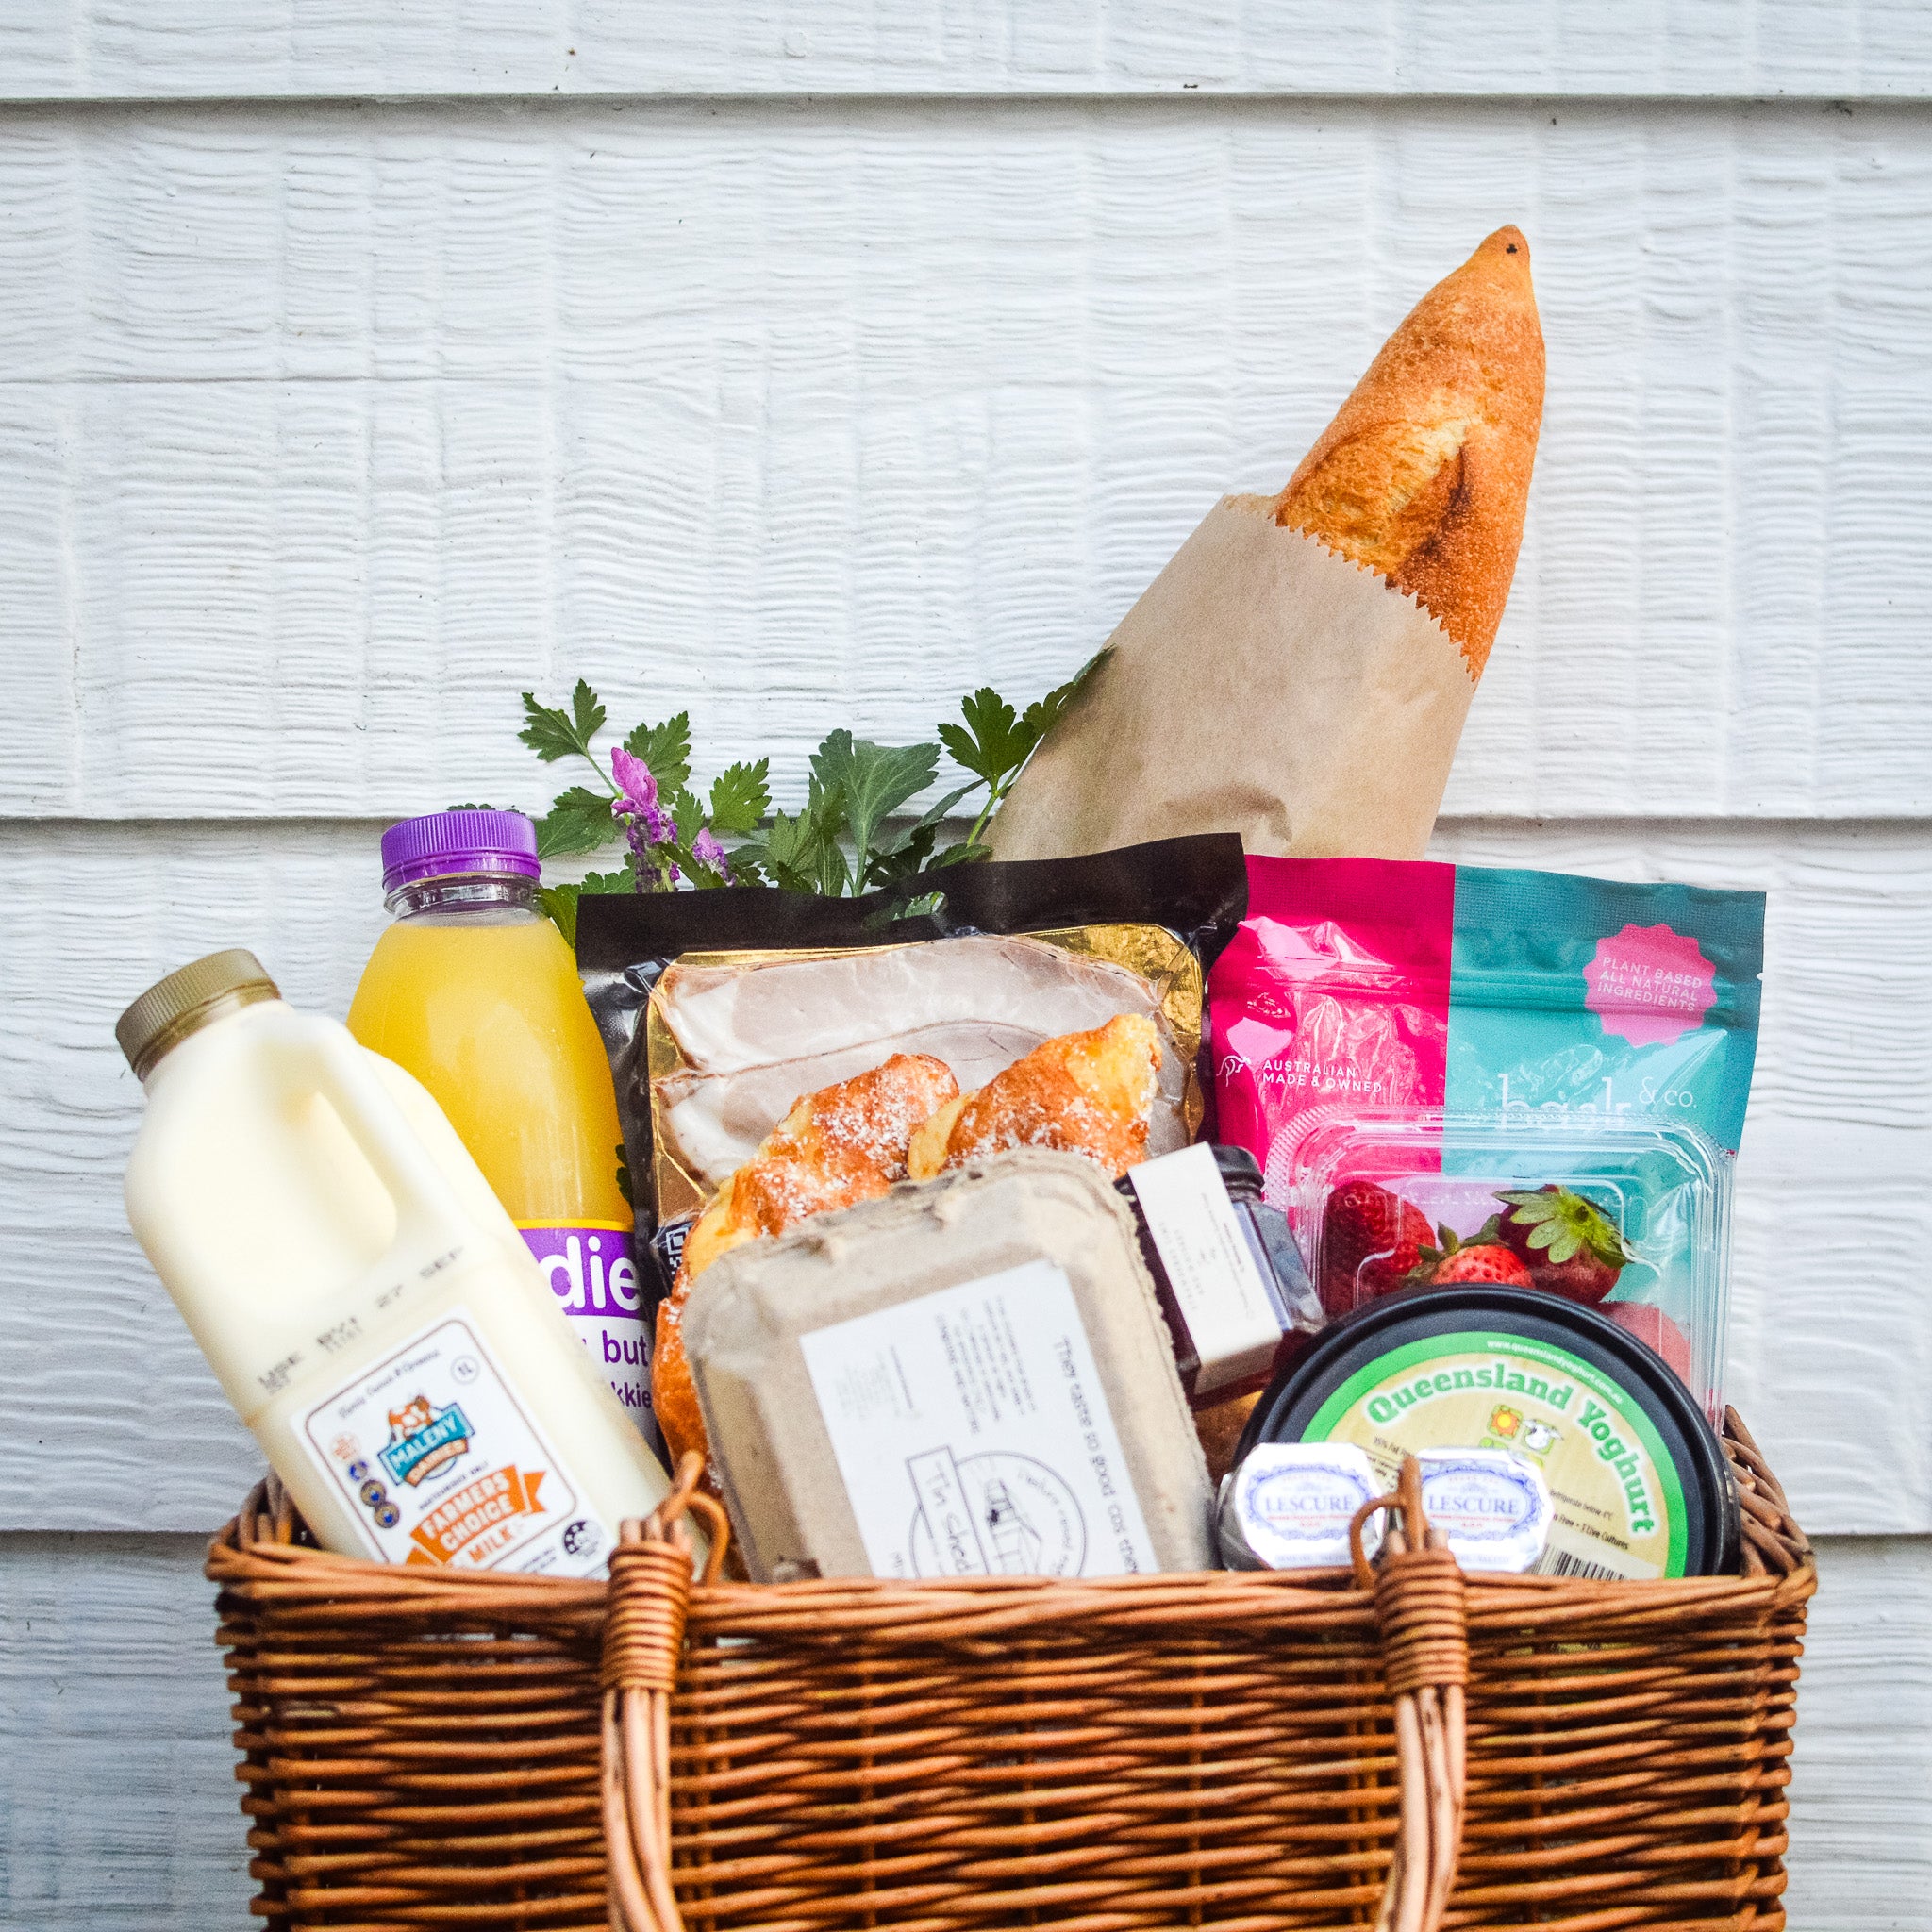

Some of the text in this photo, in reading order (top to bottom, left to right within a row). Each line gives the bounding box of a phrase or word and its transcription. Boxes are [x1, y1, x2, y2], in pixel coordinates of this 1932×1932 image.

[1600, 970, 1698, 1001] ALL NATURAL
[1603, 957, 1703, 989] PLANT BASED
[1597, 982, 1695, 1011] INGREDIENTS
[1262, 1073, 1383, 1093] MADE & OWNED
[1263, 1059, 1356, 1078] AUSTRALIAN
[1639, 1076, 1659, 1104] &
[1664, 1089, 1697, 1108] co.
[539, 1235, 641, 1311] die
[602, 1329, 649, 1367] but
[389, 1413, 458, 1470] MALENY
[1366, 1363, 1656, 1533] Queensland Yoghurt
[1089, 1454, 1117, 1497] good
[421, 1471, 510, 1540] FARMERS
[1265, 1493, 1355, 1512] LESCURE
[1428, 1494, 1521, 1515] LESCURE
[440, 1493, 515, 1552] CHOICE
[467, 1526, 514, 1563] MILK
